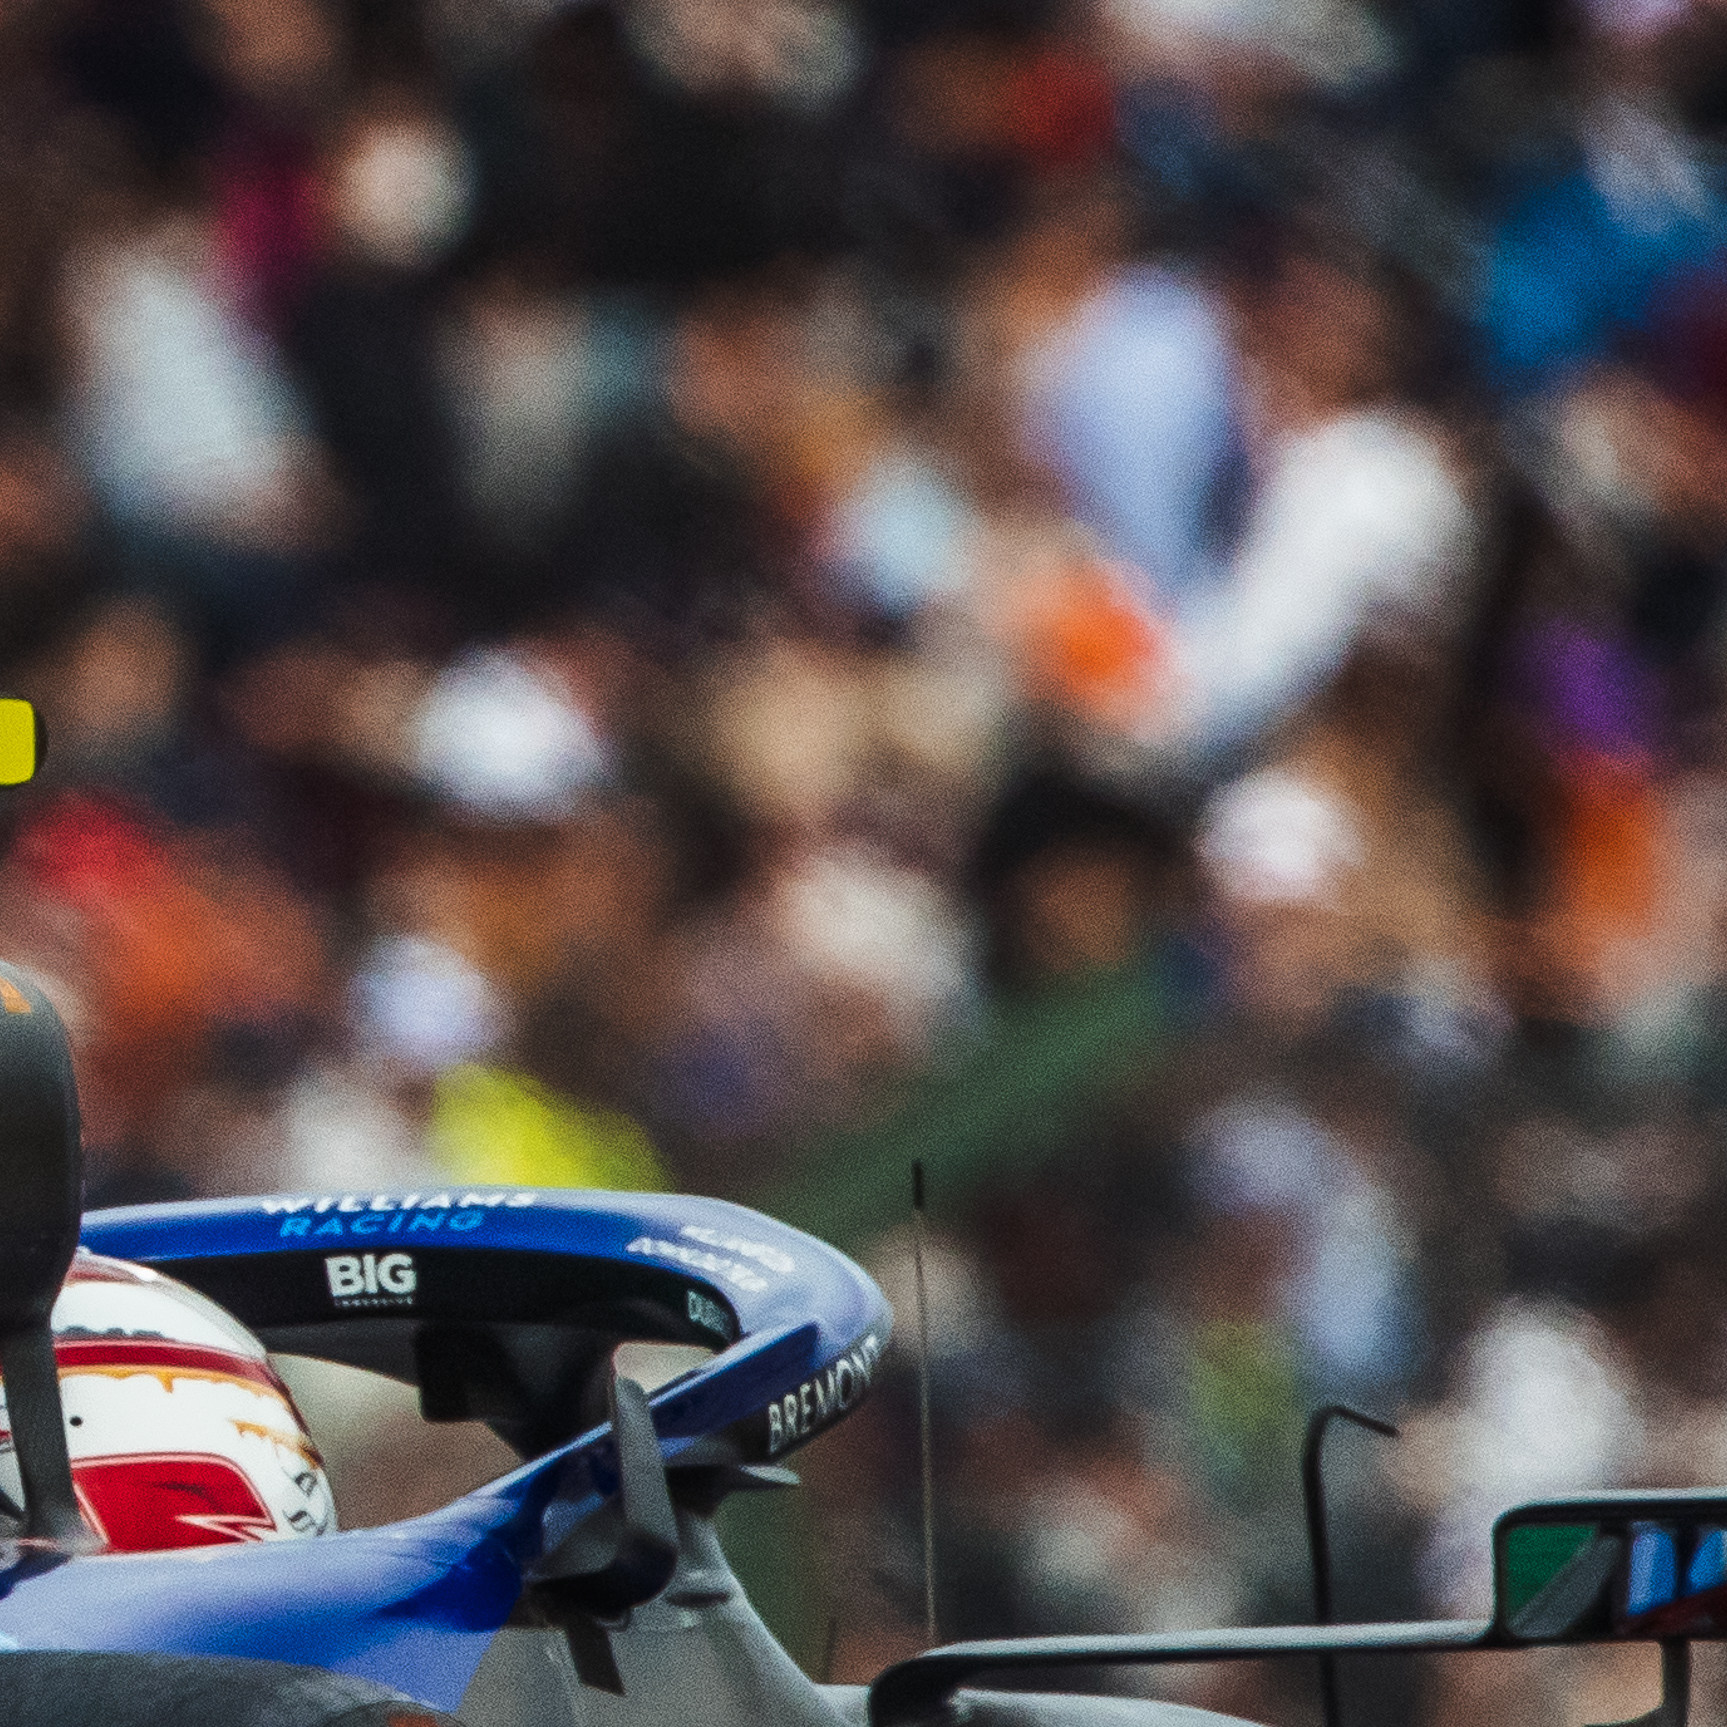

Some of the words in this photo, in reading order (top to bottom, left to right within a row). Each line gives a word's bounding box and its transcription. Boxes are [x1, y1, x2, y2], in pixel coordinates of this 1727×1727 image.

[261, 1191, 539, 1215] WILLIAMS
[278, 1210, 486, 1239] RACING
[324, 1252, 418, 1299] BIG
